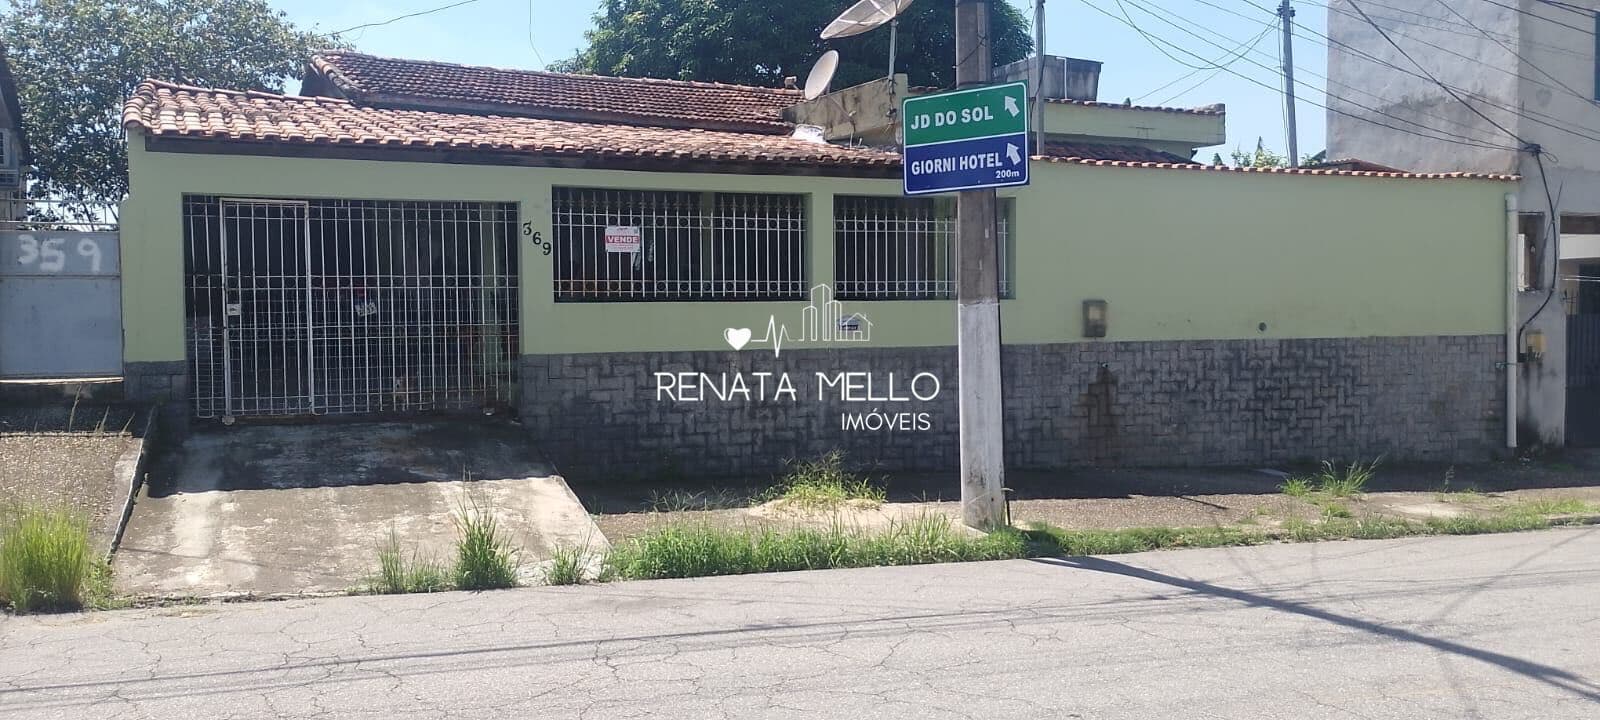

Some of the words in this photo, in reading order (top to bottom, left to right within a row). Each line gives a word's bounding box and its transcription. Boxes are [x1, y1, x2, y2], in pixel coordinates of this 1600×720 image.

[911, 114, 931, 130] JD
[935, 110, 957, 127] DO
[961, 106, 994, 123] SOL
[911, 157, 956, 175] GIORNI
[959, 152, 1003, 171] HOTEL
[995, 169, 1020, 179] 200m
[522, 220, 552, 256] 369
[17, 233, 102, 274] 359
